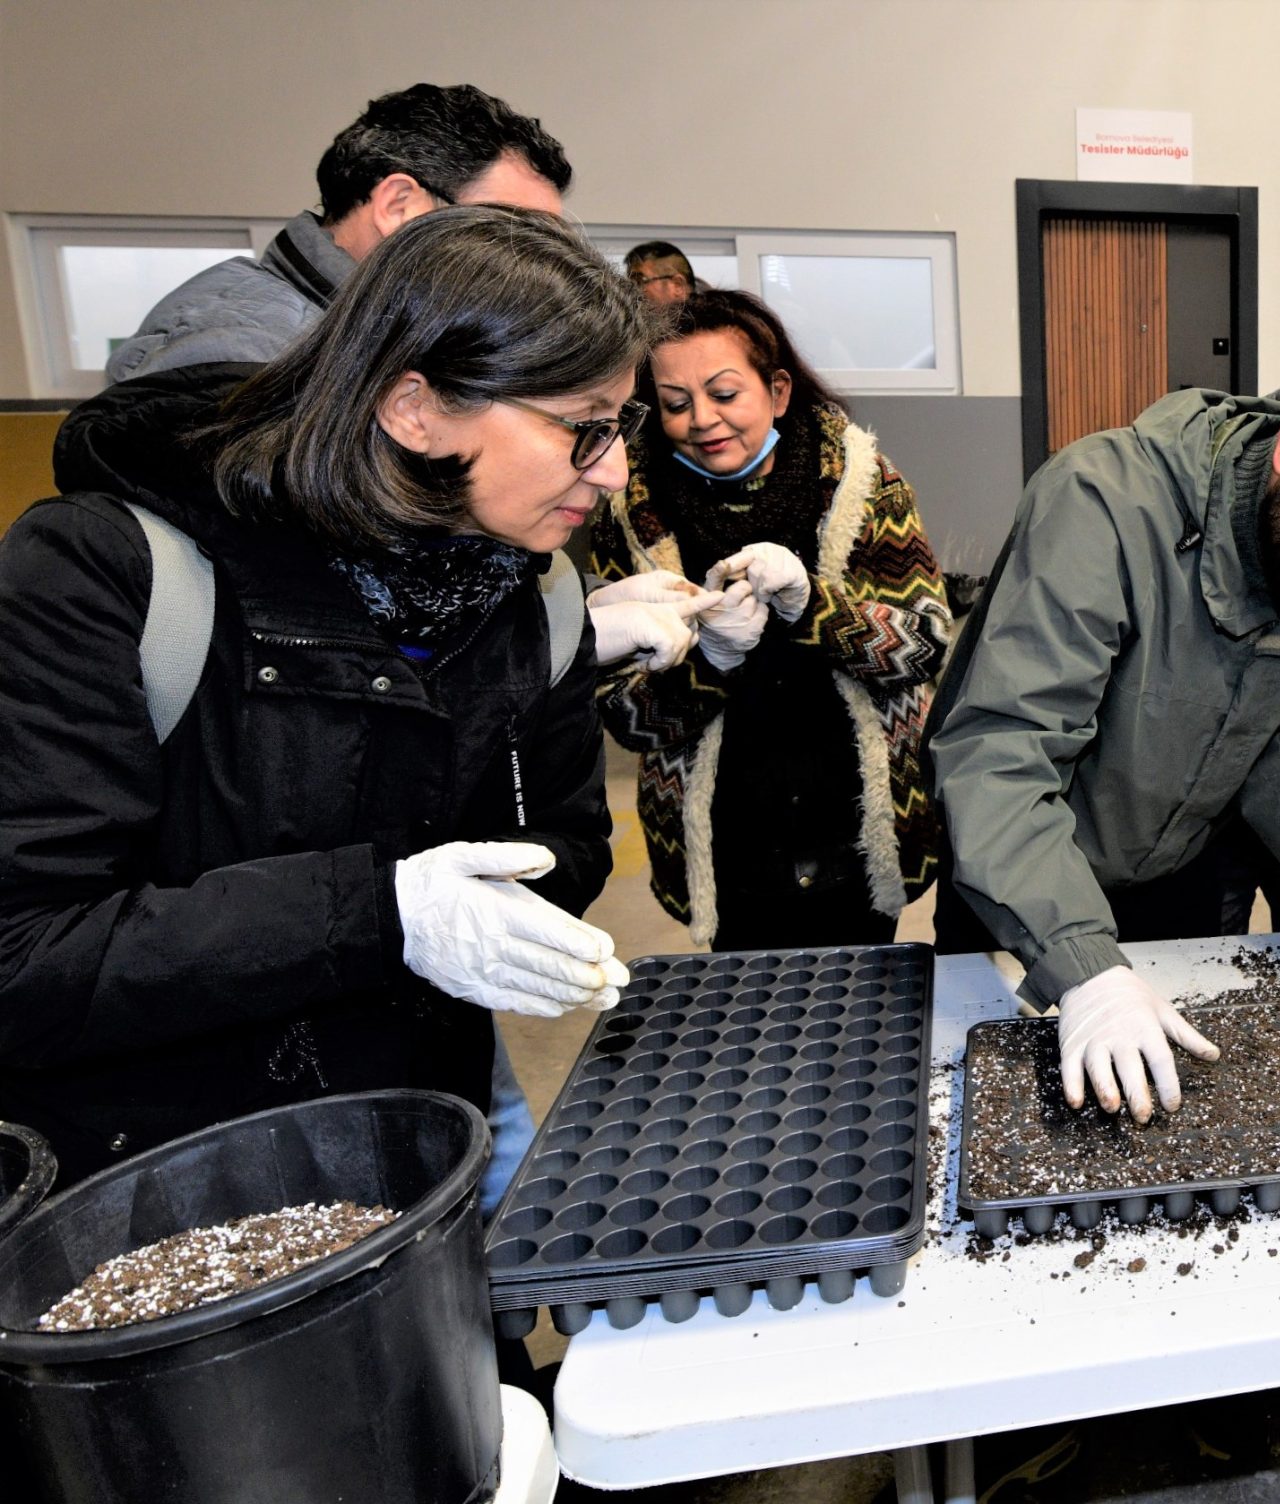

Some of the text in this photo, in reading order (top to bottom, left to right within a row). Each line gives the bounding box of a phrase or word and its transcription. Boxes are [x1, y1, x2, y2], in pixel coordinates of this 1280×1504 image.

[1081, 143, 1189, 159] Tesisler Müdürlüğü
[511, 750, 526, 826] FUTURE IS NOW
